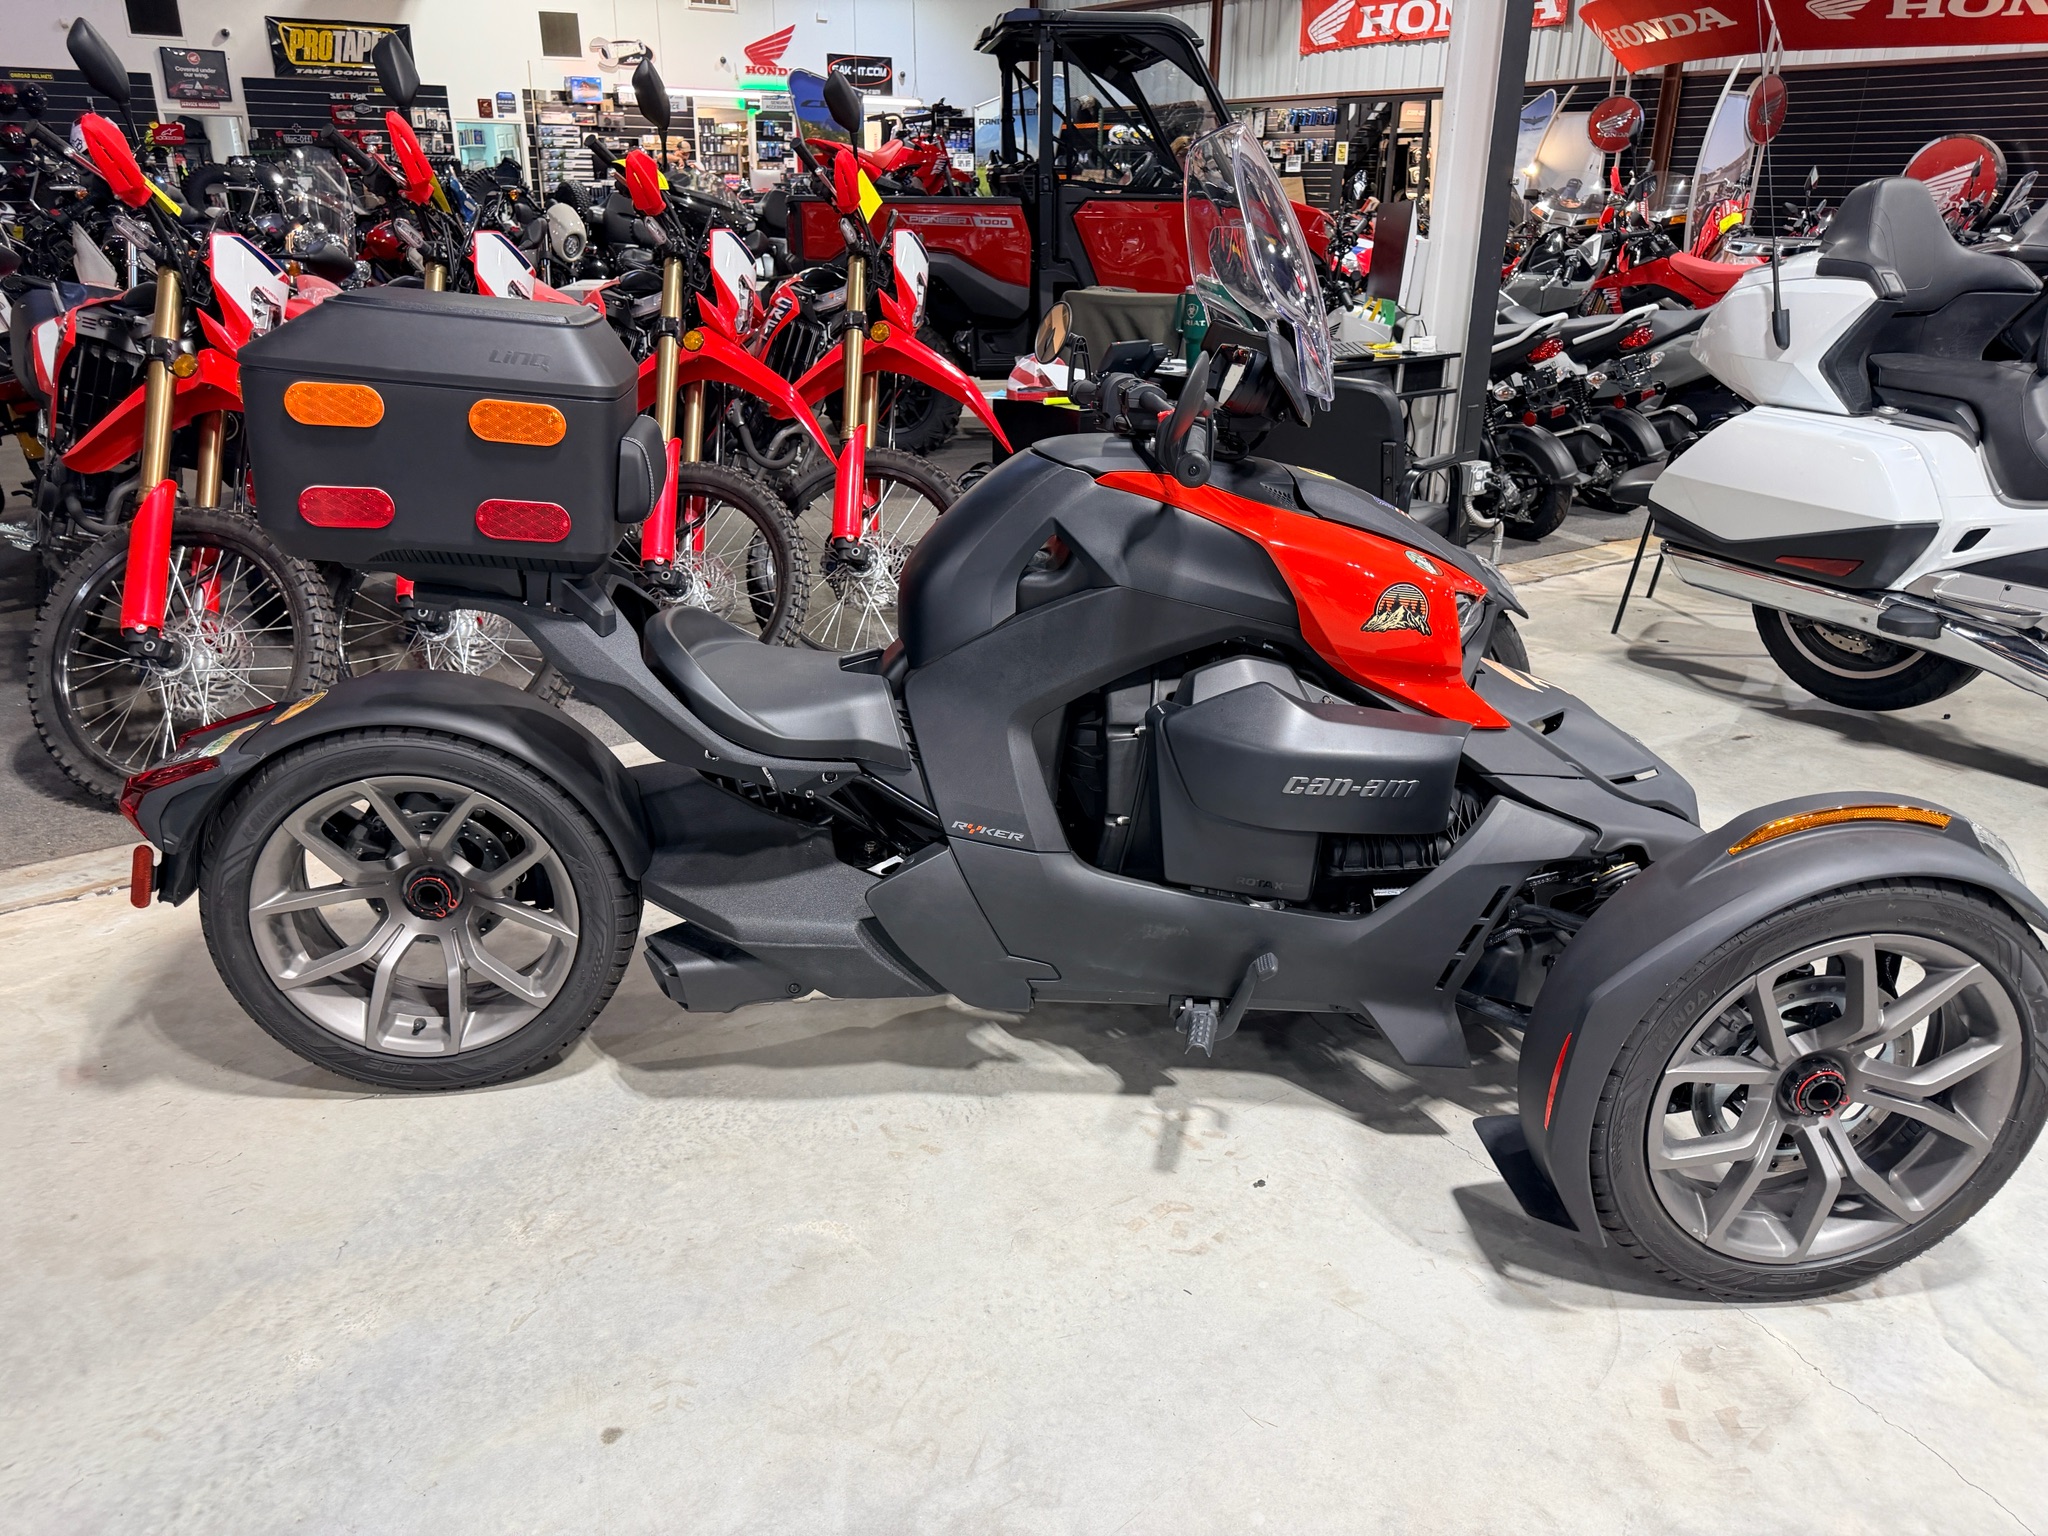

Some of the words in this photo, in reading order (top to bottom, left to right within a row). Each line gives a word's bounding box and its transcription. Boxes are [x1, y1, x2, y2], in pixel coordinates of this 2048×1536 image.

[1604, 7, 1738, 49] HONDA
[175, 65, 199, 73] Covered
[295, 68, 331, 76] TAKE
[745, 65, 792, 76] HOND
[908, 216, 966, 224] PIONEER
[262, 286, 279, 302] HONDA
[1282, 776, 1420, 797] can-am
[951, 821, 1025, 842] RYKER
[1236, 876, 1283, 891] ROTAX
[1653, 990, 1709, 1054] KENDA
